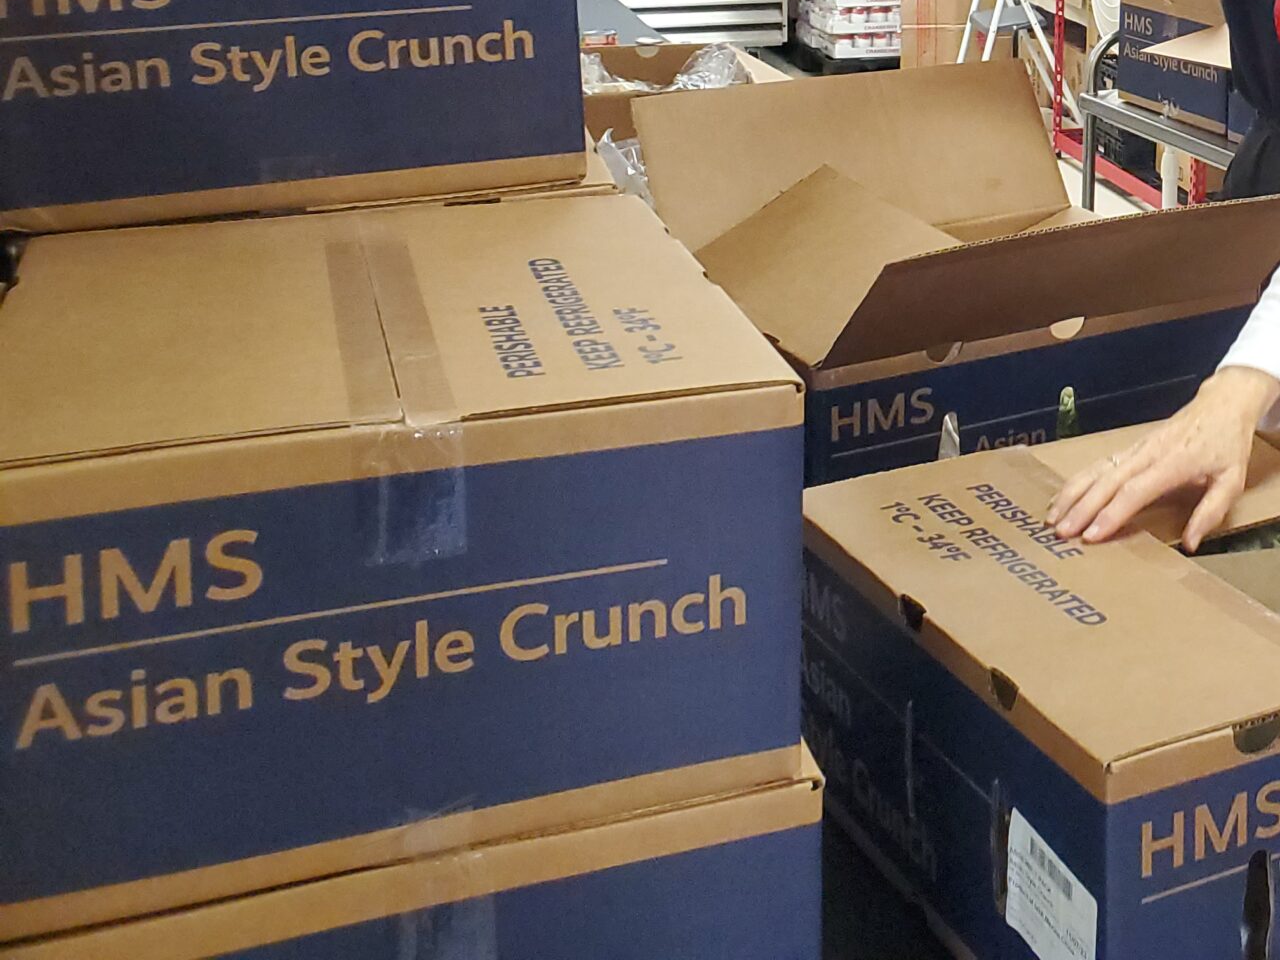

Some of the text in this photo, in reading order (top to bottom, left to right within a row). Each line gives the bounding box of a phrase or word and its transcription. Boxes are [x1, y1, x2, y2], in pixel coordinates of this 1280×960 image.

[2, 20, 535, 101] Asian Style Crunch
[1123, 11, 1153, 36] HMS
[1123, 42, 1218, 83] Asian Style Crunch
[478, 304, 546, 378] PERISHABLE
[528, 257, 625, 371] KEEP REFRIGERATED
[831, 387, 935, 442] HMS
[976, 427, 1046, 452] Asian
[880, 501, 921, 524] 1°C
[917, 533, 972, 562] 34°F
[966, 483, 1084, 560] PERISHABLE
[10, 530, 265, 635] HMS
[918, 493, 1107, 626] KEEP REFRIGERATED
[16, 575, 748, 750] Asian Style Crunch
